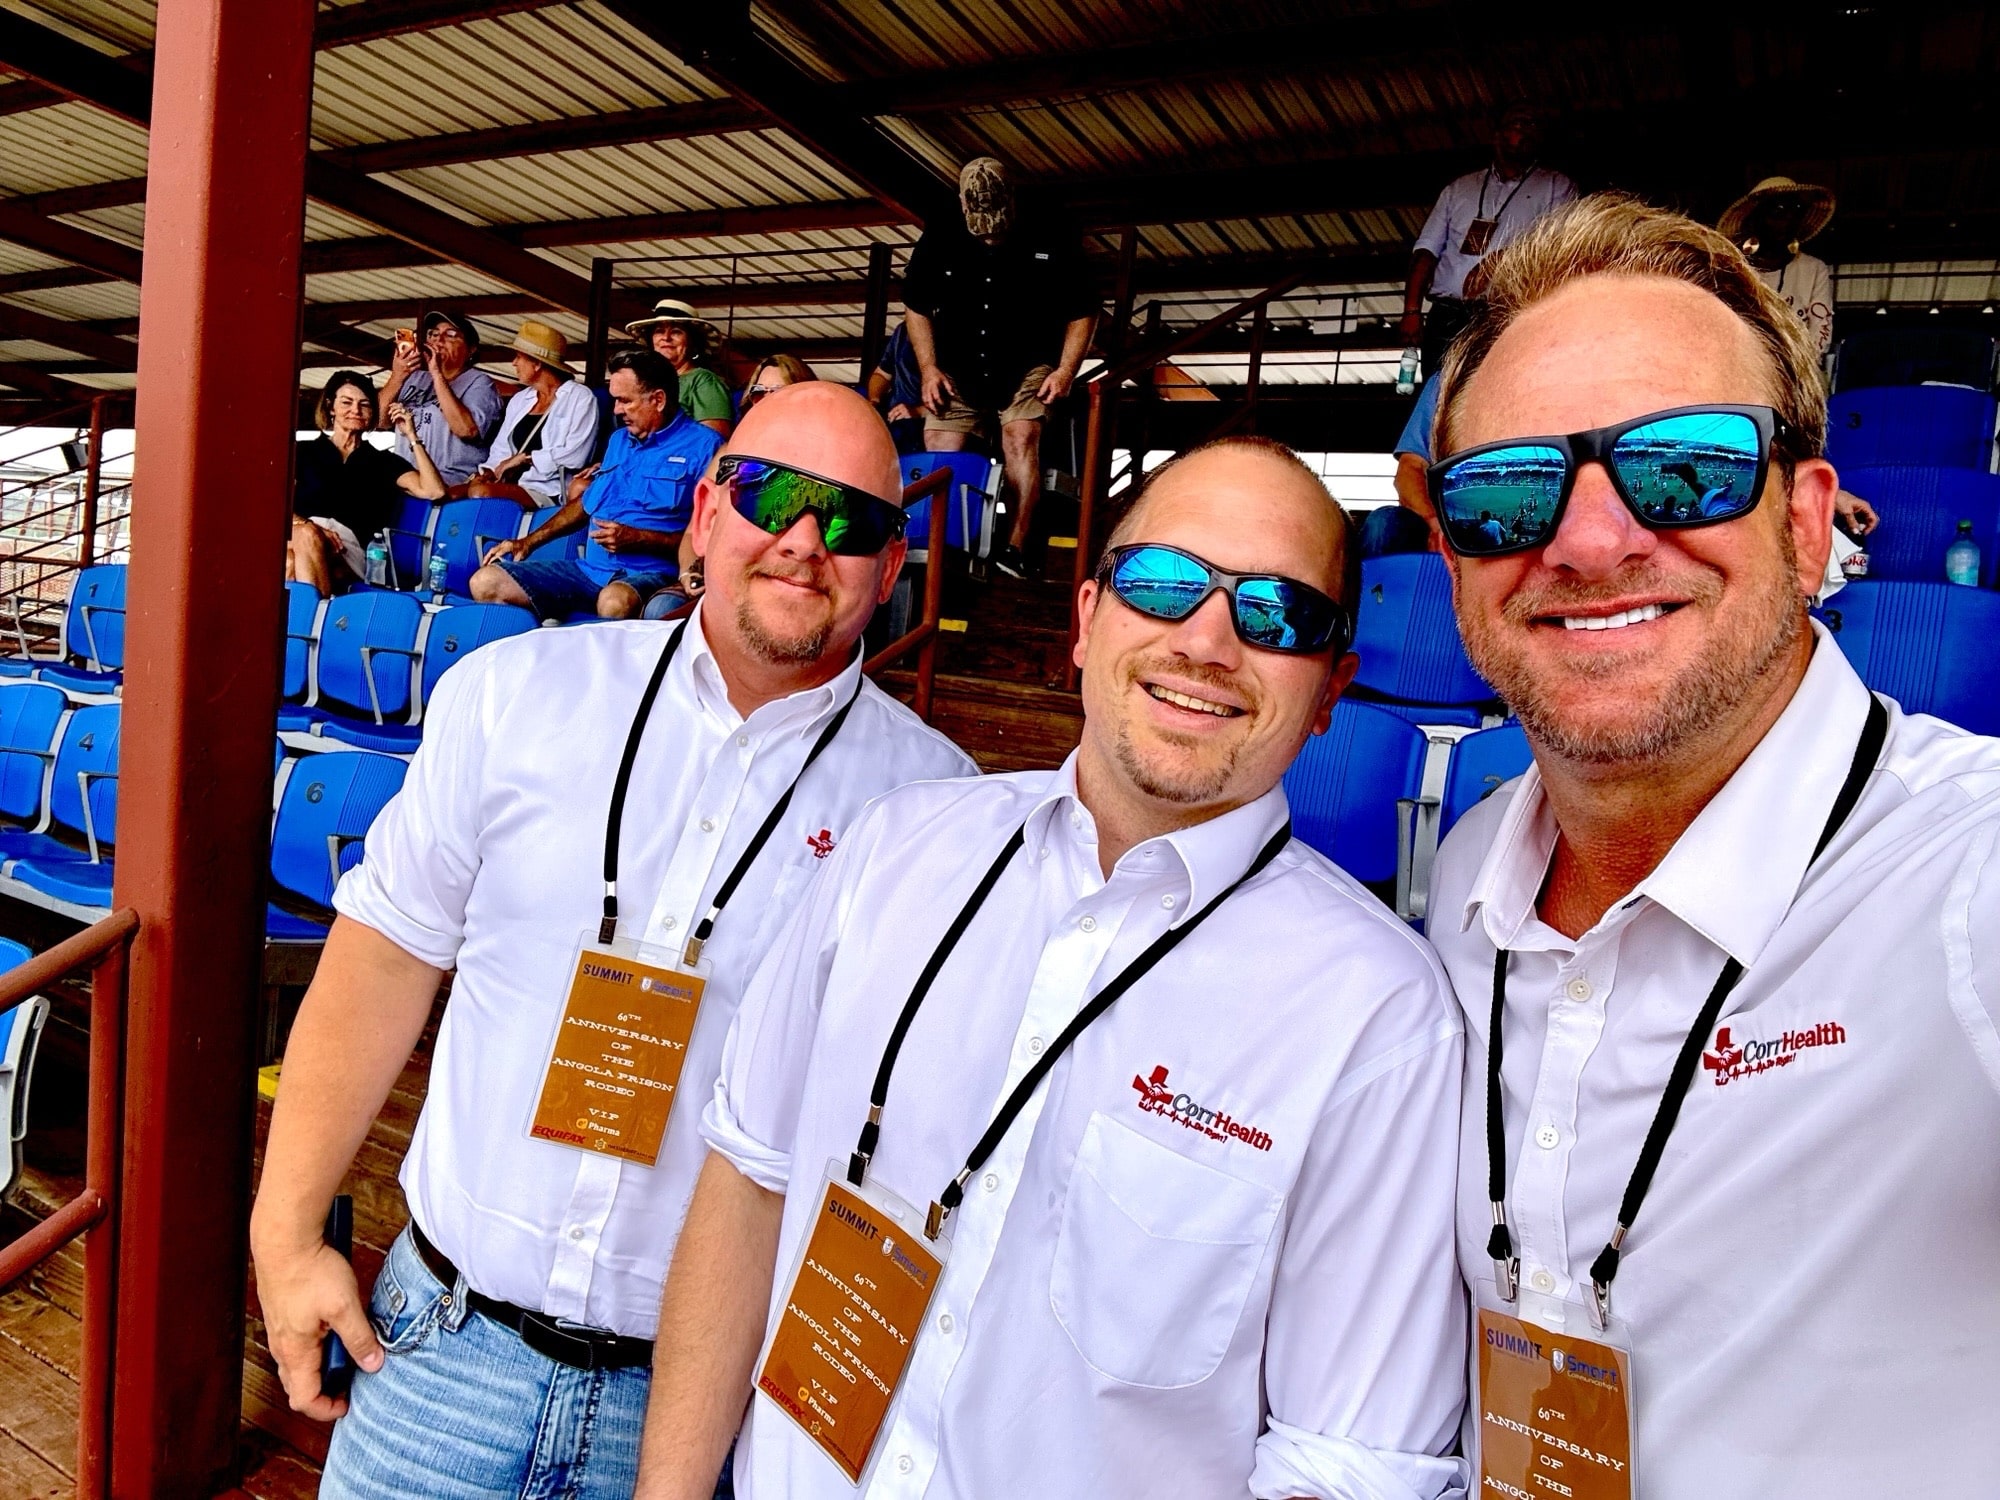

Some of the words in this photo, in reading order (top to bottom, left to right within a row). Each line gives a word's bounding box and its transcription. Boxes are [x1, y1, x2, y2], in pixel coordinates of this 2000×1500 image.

[1847, 411, 1862, 429] 3
[910, 467, 922, 480] 6
[1842, 555, 1867, 567] oke
[89, 583, 98, 598] 1
[1371, 583, 1383, 604] 1
[335, 616, 349, 631] 4
[1823, 608, 1843, 633] 3
[444, 634, 459, 653] 5
[79, 732, 95, 751] 4
[306, 782, 326, 804] 6
[583, 963, 634, 985] SUMMIT
[565, 1016, 684, 1050] ANNIVERSARY
[1743, 1022, 1846, 1064] CorrHealth
[611, 1041, 632, 1052] OF
[601, 1053, 634, 1068] THE
[551, 1057, 614, 1078] ANGOLA
[617, 1072, 674, 1093] PRISON
[584, 1079, 635, 1097] RODEO
[588, 1107, 619, 1121] VIP
[1172, 1093, 1273, 1152] CorrHealth
[533, 1125, 586, 1144] EQUIFAX
[588, 1121, 620, 1137] Pharma
[829, 1200, 878, 1240] SUMMIT
[806, 1258, 910, 1346] ANNIVERSARY
[842, 1306, 863, 1325] OF
[832, 1316, 862, 1347] THE
[787, 1302, 841, 1351] ANGOLA
[842, 1347, 891, 1397] PRISON
[1487, 1328, 1542, 1360] SUMMIT
[812, 1341, 857, 1385] RODEO
[1567, 1355, 1617, 1383] Smart
[760, 1375, 807, 1419] EQUIFAX
[811, 1378, 839, 1405] VIP
[807, 1396, 836, 1427] Pharma
[1484, 1411, 1624, 1472] ANNIVERSARY
[1540, 1455, 1564, 1470] OF
[1533, 1473, 1573, 1497] THE
